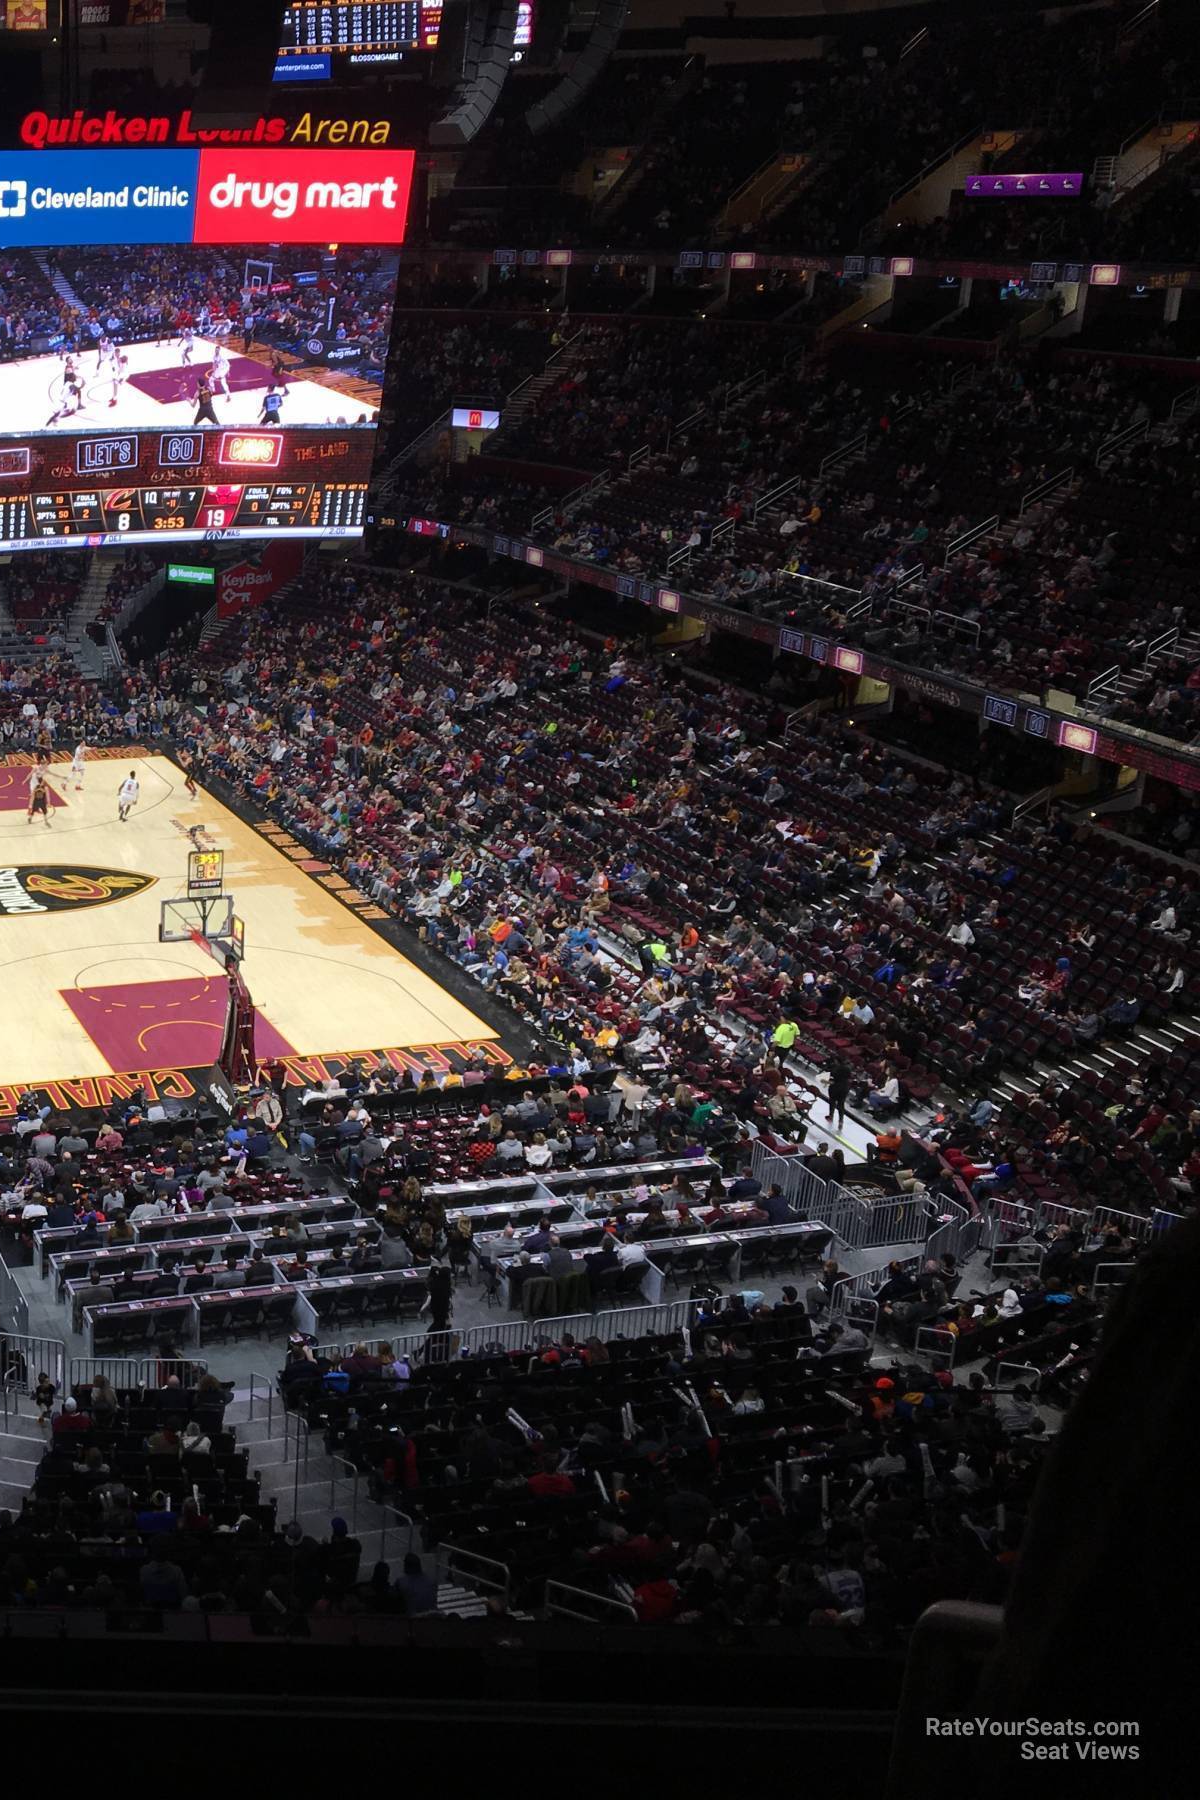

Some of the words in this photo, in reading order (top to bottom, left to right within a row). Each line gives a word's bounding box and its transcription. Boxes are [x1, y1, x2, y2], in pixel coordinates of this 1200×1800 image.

[350, 53, 398, 62] BLOSSOMGAME
[20, 110, 170, 148] Quicken
[290, 112, 391, 144] Arena
[30, 186, 130, 209] Cleveland
[133, 184, 189, 207] Clinic
[209, 173, 299, 219] drug
[305, 175, 398, 209] mart
[328, 348, 344, 359] drug
[85, 441, 131, 467] LET'S
[167, 438, 193, 461] GO
[295, 447, 316, 461] THE
[276, 486, 293, 495] FG%
[296, 487, 307, 495] 47
[36, 497, 52, 505] FG%
[56, 496, 64, 504] 19
[189, 492, 196, 501] 7
[251, 502, 259, 512] 0
[270, 502, 291, 511] 3PT%
[292, 501, 303, 510] 33
[36, 511, 56, 520] 3PT%
[58, 510, 69, 519] 50
[82, 508, 90, 518] 2
[207, 509, 225, 527] 19
[118, 512, 131, 531] 8
[154, 517, 185, 529] 3:53
[288, 516, 296, 525] 7
[108, 535, 122, 543] DET
[329, 527, 346, 535] 2.00
[222, 569, 273, 588] KeyBank
